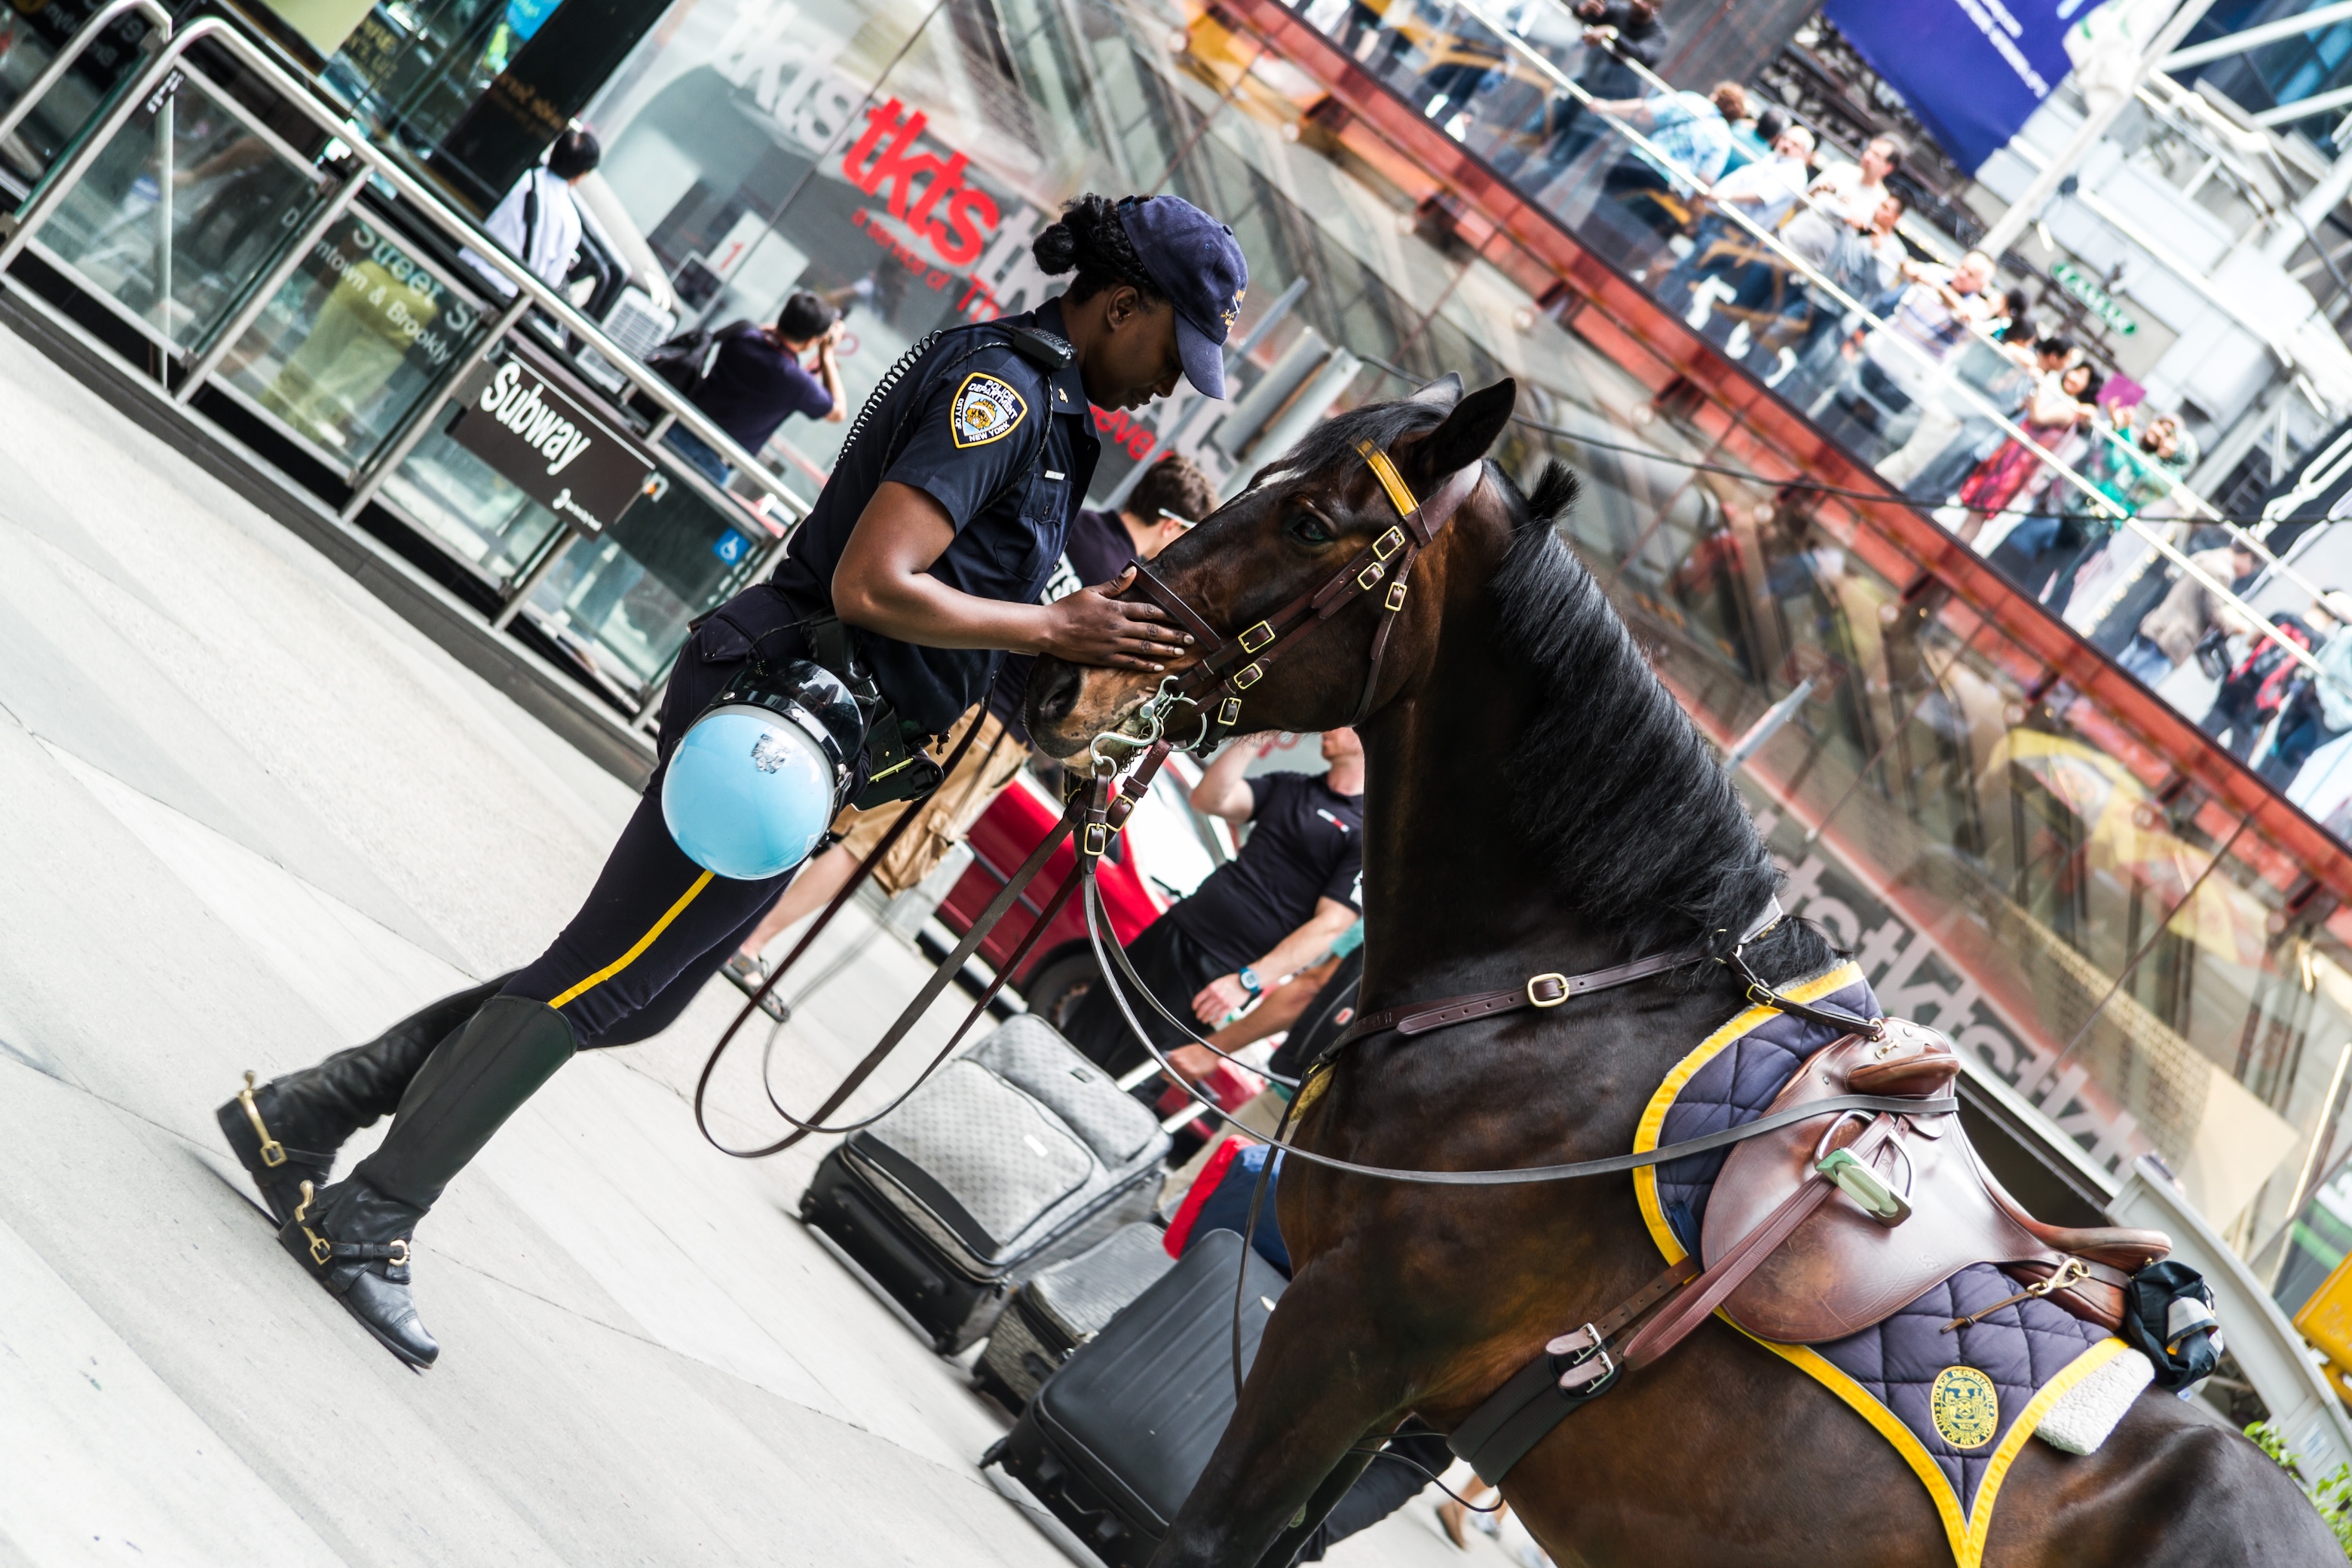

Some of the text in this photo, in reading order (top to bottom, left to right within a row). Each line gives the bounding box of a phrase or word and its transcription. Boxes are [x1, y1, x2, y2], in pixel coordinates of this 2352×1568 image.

[712, 0, 861, 152] tkts
[841, 97, 1000, 267] tkts
[968, 383, 1018, 419] DEPARTMENT
[985, 379, 1015, 403] POLICE
[480, 361, 592, 476] Subway
[955, 398, 964, 430] CITY OF
[969, 421, 1010, 442] NEW YORK
[1934, 1370, 1995, 1404] POLICE DEPARTMENT
[1935, 1413, 1948, 1432] CITY
[1946, 1432, 1959, 1443] OF
[1960, 1436, 1980, 1444] NEW
[1981, 1416, 1995, 1438] YORK
